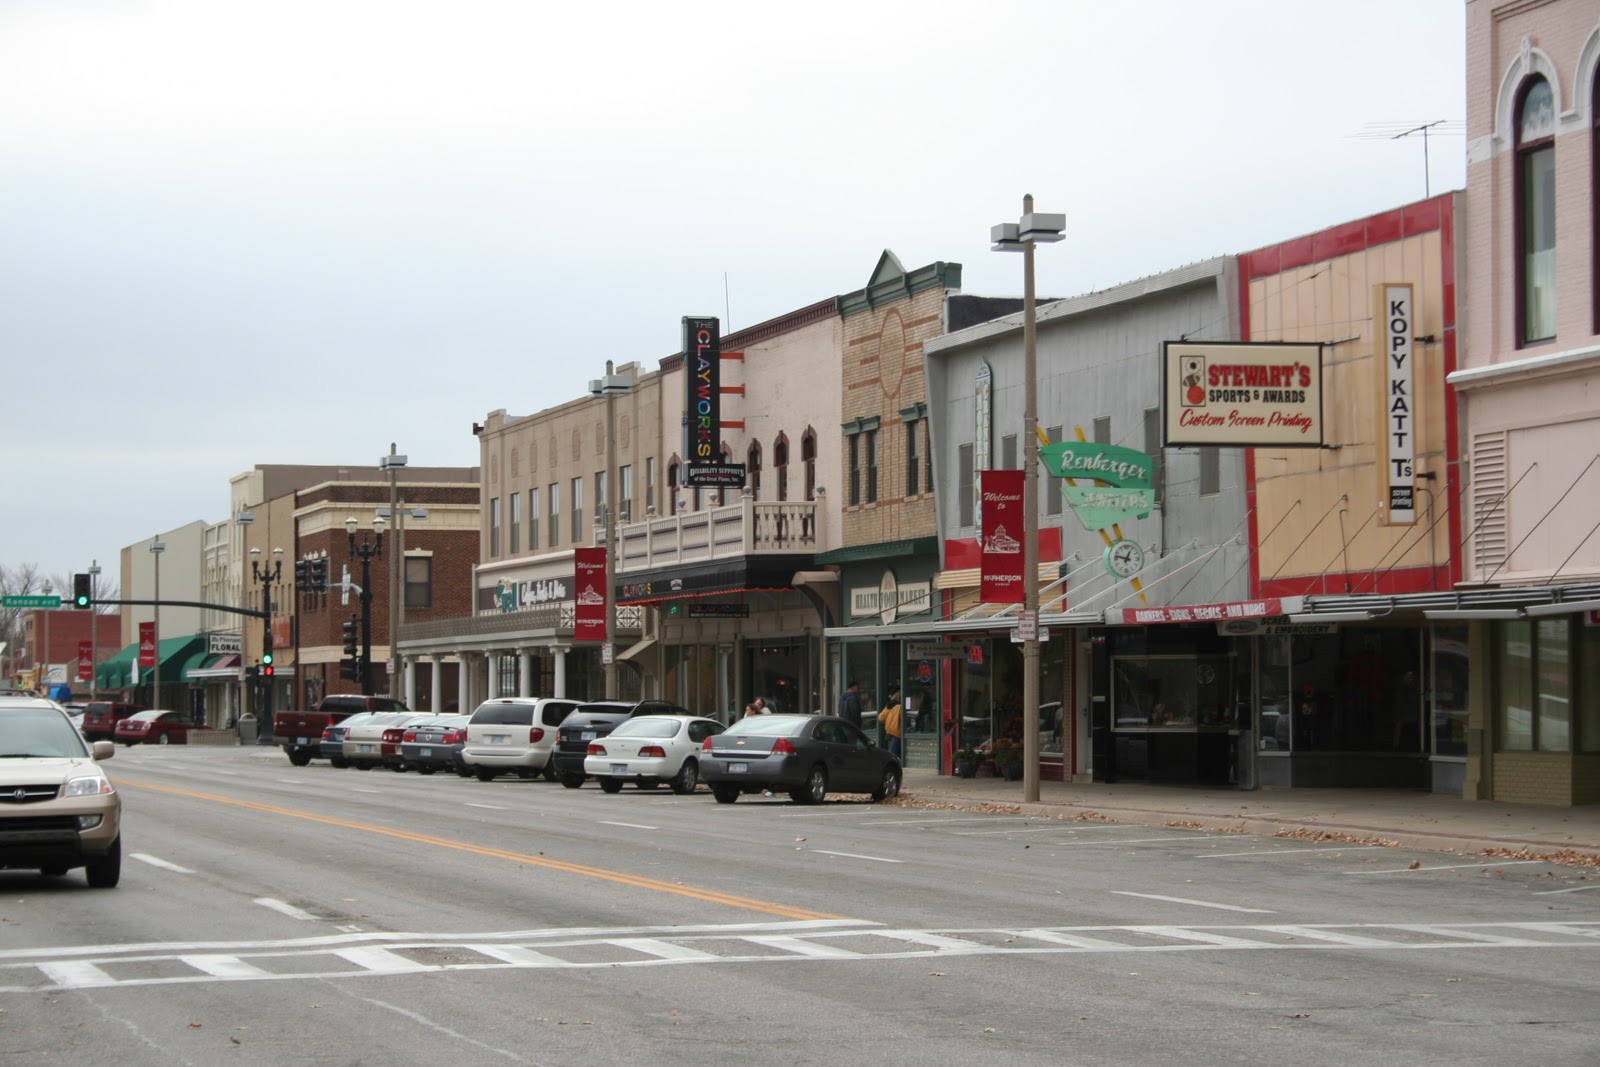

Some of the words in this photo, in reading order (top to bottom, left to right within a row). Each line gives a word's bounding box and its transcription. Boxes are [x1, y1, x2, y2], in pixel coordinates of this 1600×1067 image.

[694, 321, 714, 329] THE
[1390, 300, 1408, 370] KOPY
[1208, 361, 1311, 388] STEWART'S
[697, 329, 711, 457] CLAYWORKS
[1209, 389, 1251, 403] SPORTS
[1253, 390, 1260, 401] &
[1262, 390, 1306, 403] AWARDS
[1179, 408, 1225, 428] Custom
[1228, 409, 1265, 428] Screen
[1267, 411, 1314, 434] Printing
[1390, 379, 1409, 448] KATT
[690, 468, 718, 477] DISABILITY
[1061, 450, 1146, 480] Renberger
[983, 492, 1021, 502] Welcome
[6, 598, 39, 606] Kansas
[855, 593, 878, 609] HEALTH
[880, 591, 897, 609] FOOD
[899, 589, 926, 605] MARKET
[1135, 610, 1166, 622] BANNERS
[1169, 608, 1191, 621] SIGNS
[1194, 607, 1222, 620] DECALS
[1226, 604, 1243, 617] AND
[1261, 614, 1291, 626] SCREE
[1274, 625, 1330, 634] EMBROIDERY
